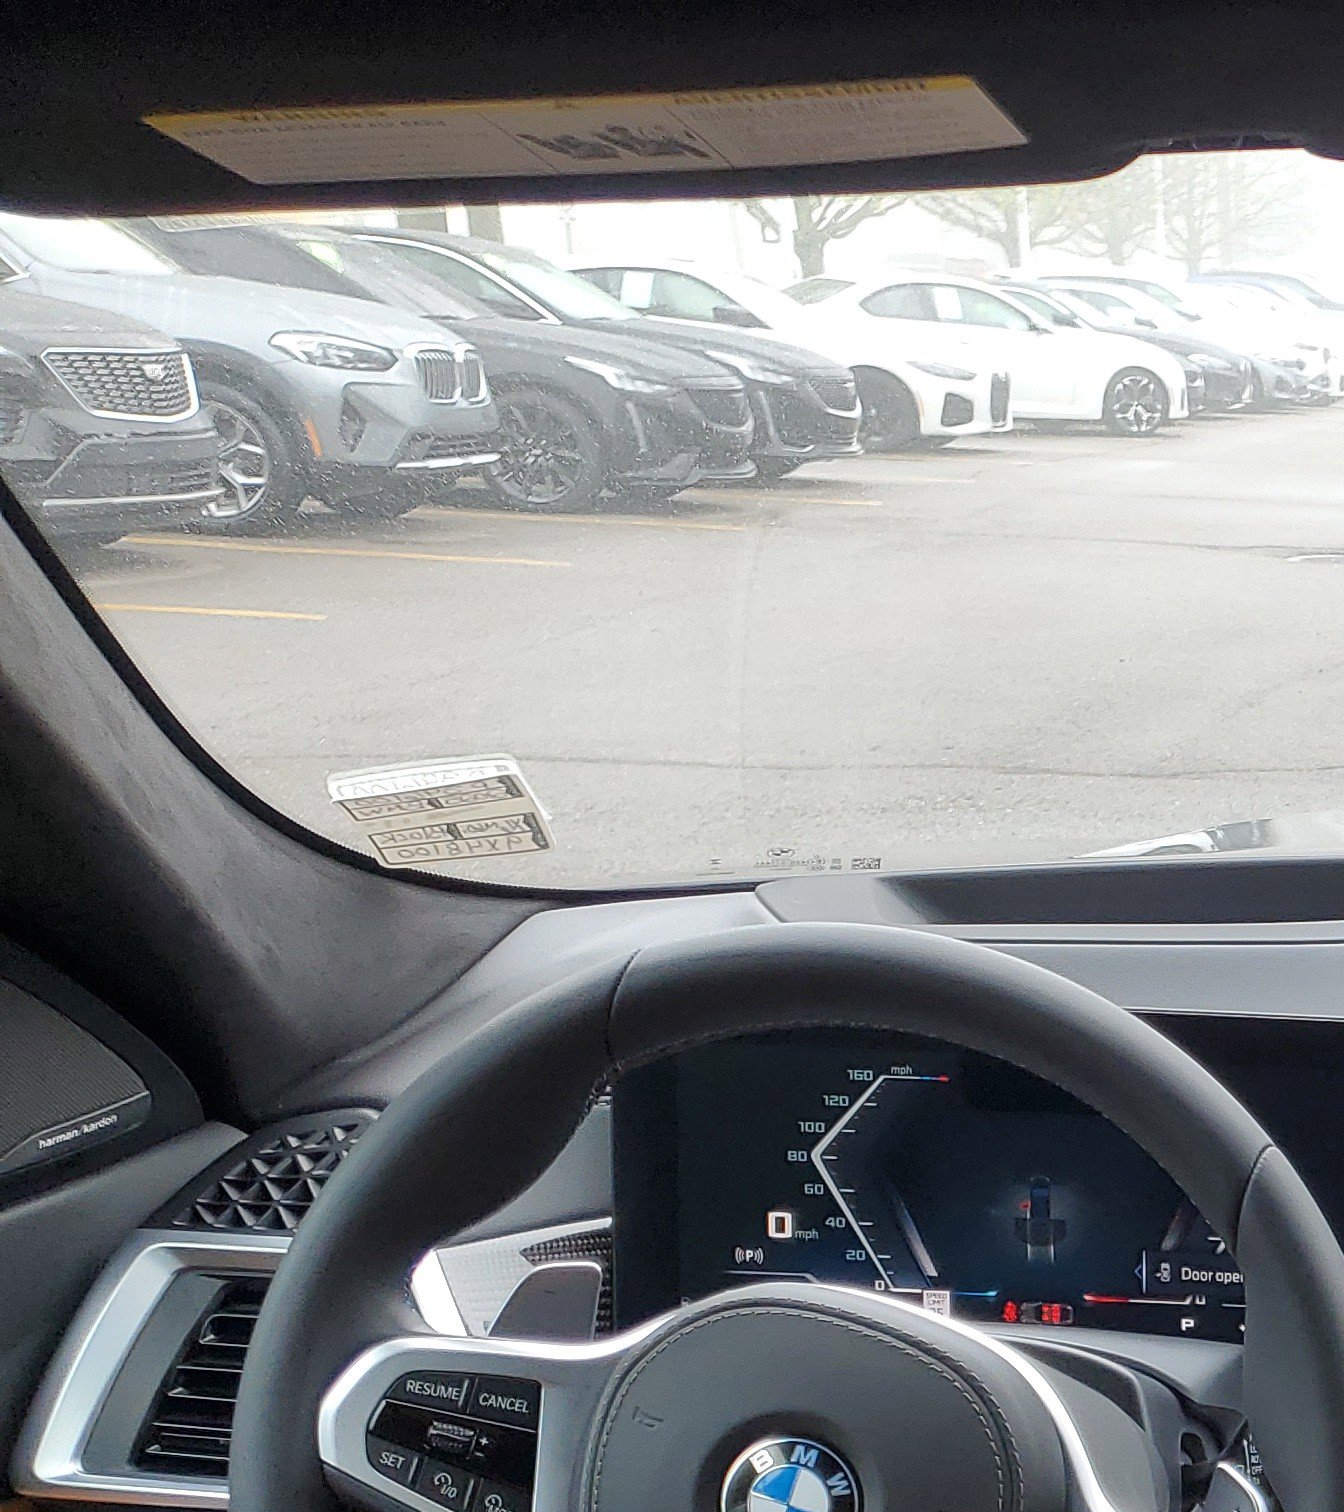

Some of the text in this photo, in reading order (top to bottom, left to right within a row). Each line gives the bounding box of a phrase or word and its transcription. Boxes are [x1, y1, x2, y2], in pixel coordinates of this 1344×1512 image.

[847, 1069, 874, 1081] 160
[890, 1065, 913, 1075] mph
[822, 1095, 849, 1107] 120
[798, 1121, 825, 1133] 100
[787, 1150, 808, 1162] 80
[804, 1183, 824, 1195] 60
[767, 1211, 819, 1241] 0 mph
[825, 1217, 846, 1228] 40
[846, 1250, 866, 1261] 20
[1181, 1267, 1213, 1282] Door
[874, 1280, 885, 1291] 0
[1181, 1318, 1195, 1331] P
[406, 1379, 461, 1400] RESUME
[478, 1393, 531, 1413] CANCEL
[379, 1451, 406, 1470] SET
[750, 1444, 851, 1497] BMW
